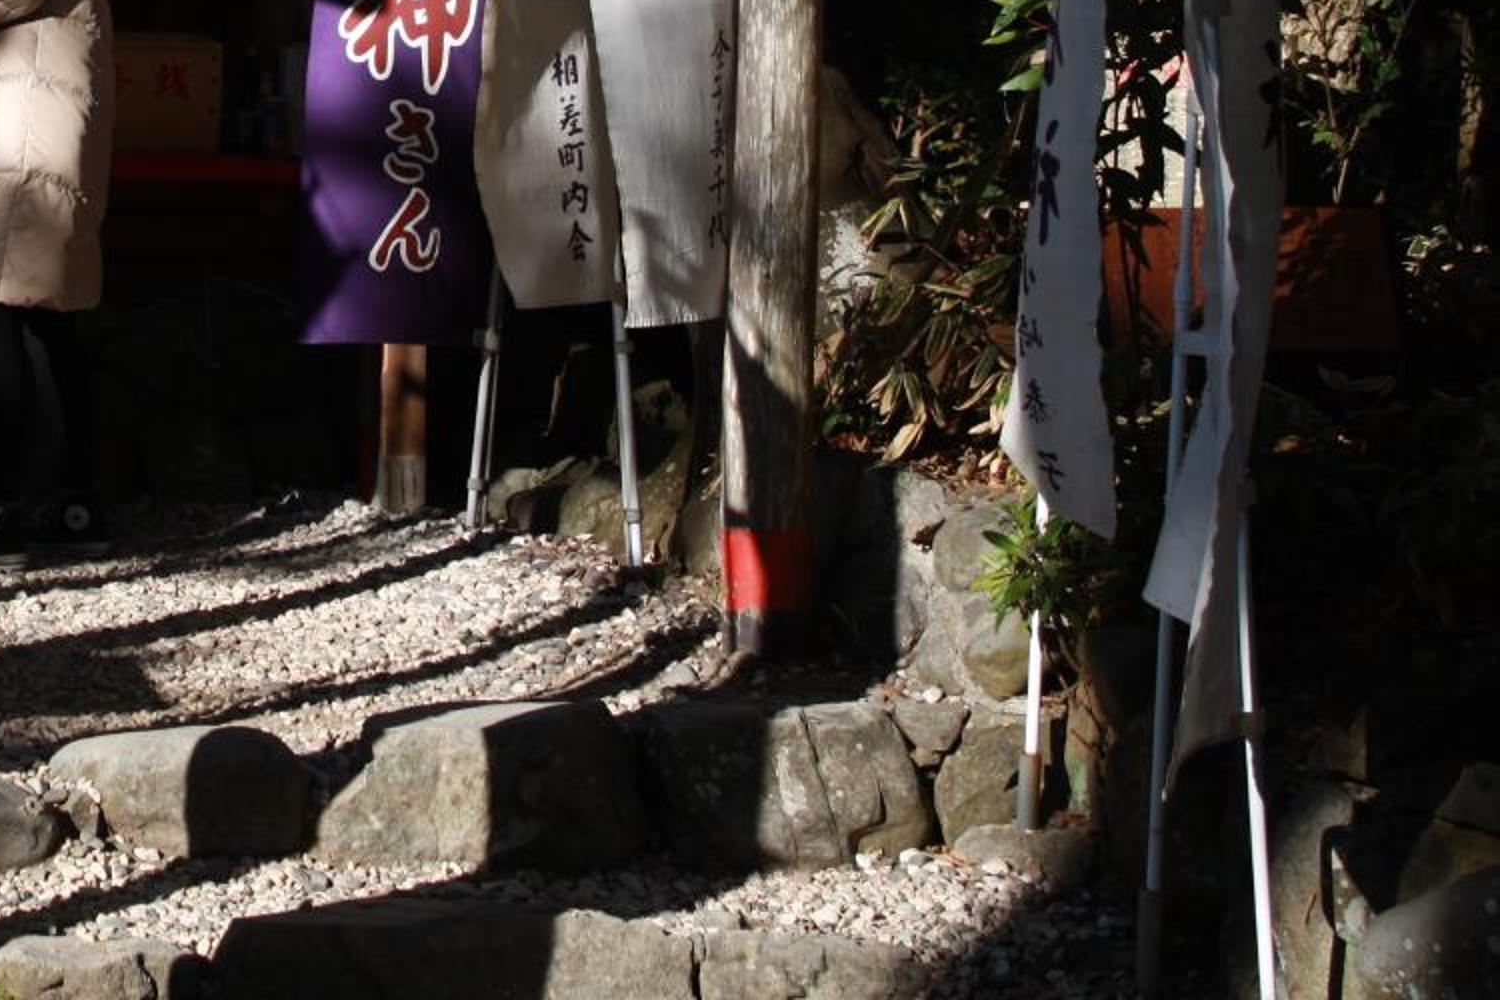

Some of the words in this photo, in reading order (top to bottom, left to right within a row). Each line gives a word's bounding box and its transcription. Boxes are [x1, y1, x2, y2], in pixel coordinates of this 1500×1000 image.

[552, 52, 594, 263] 相差町内会
